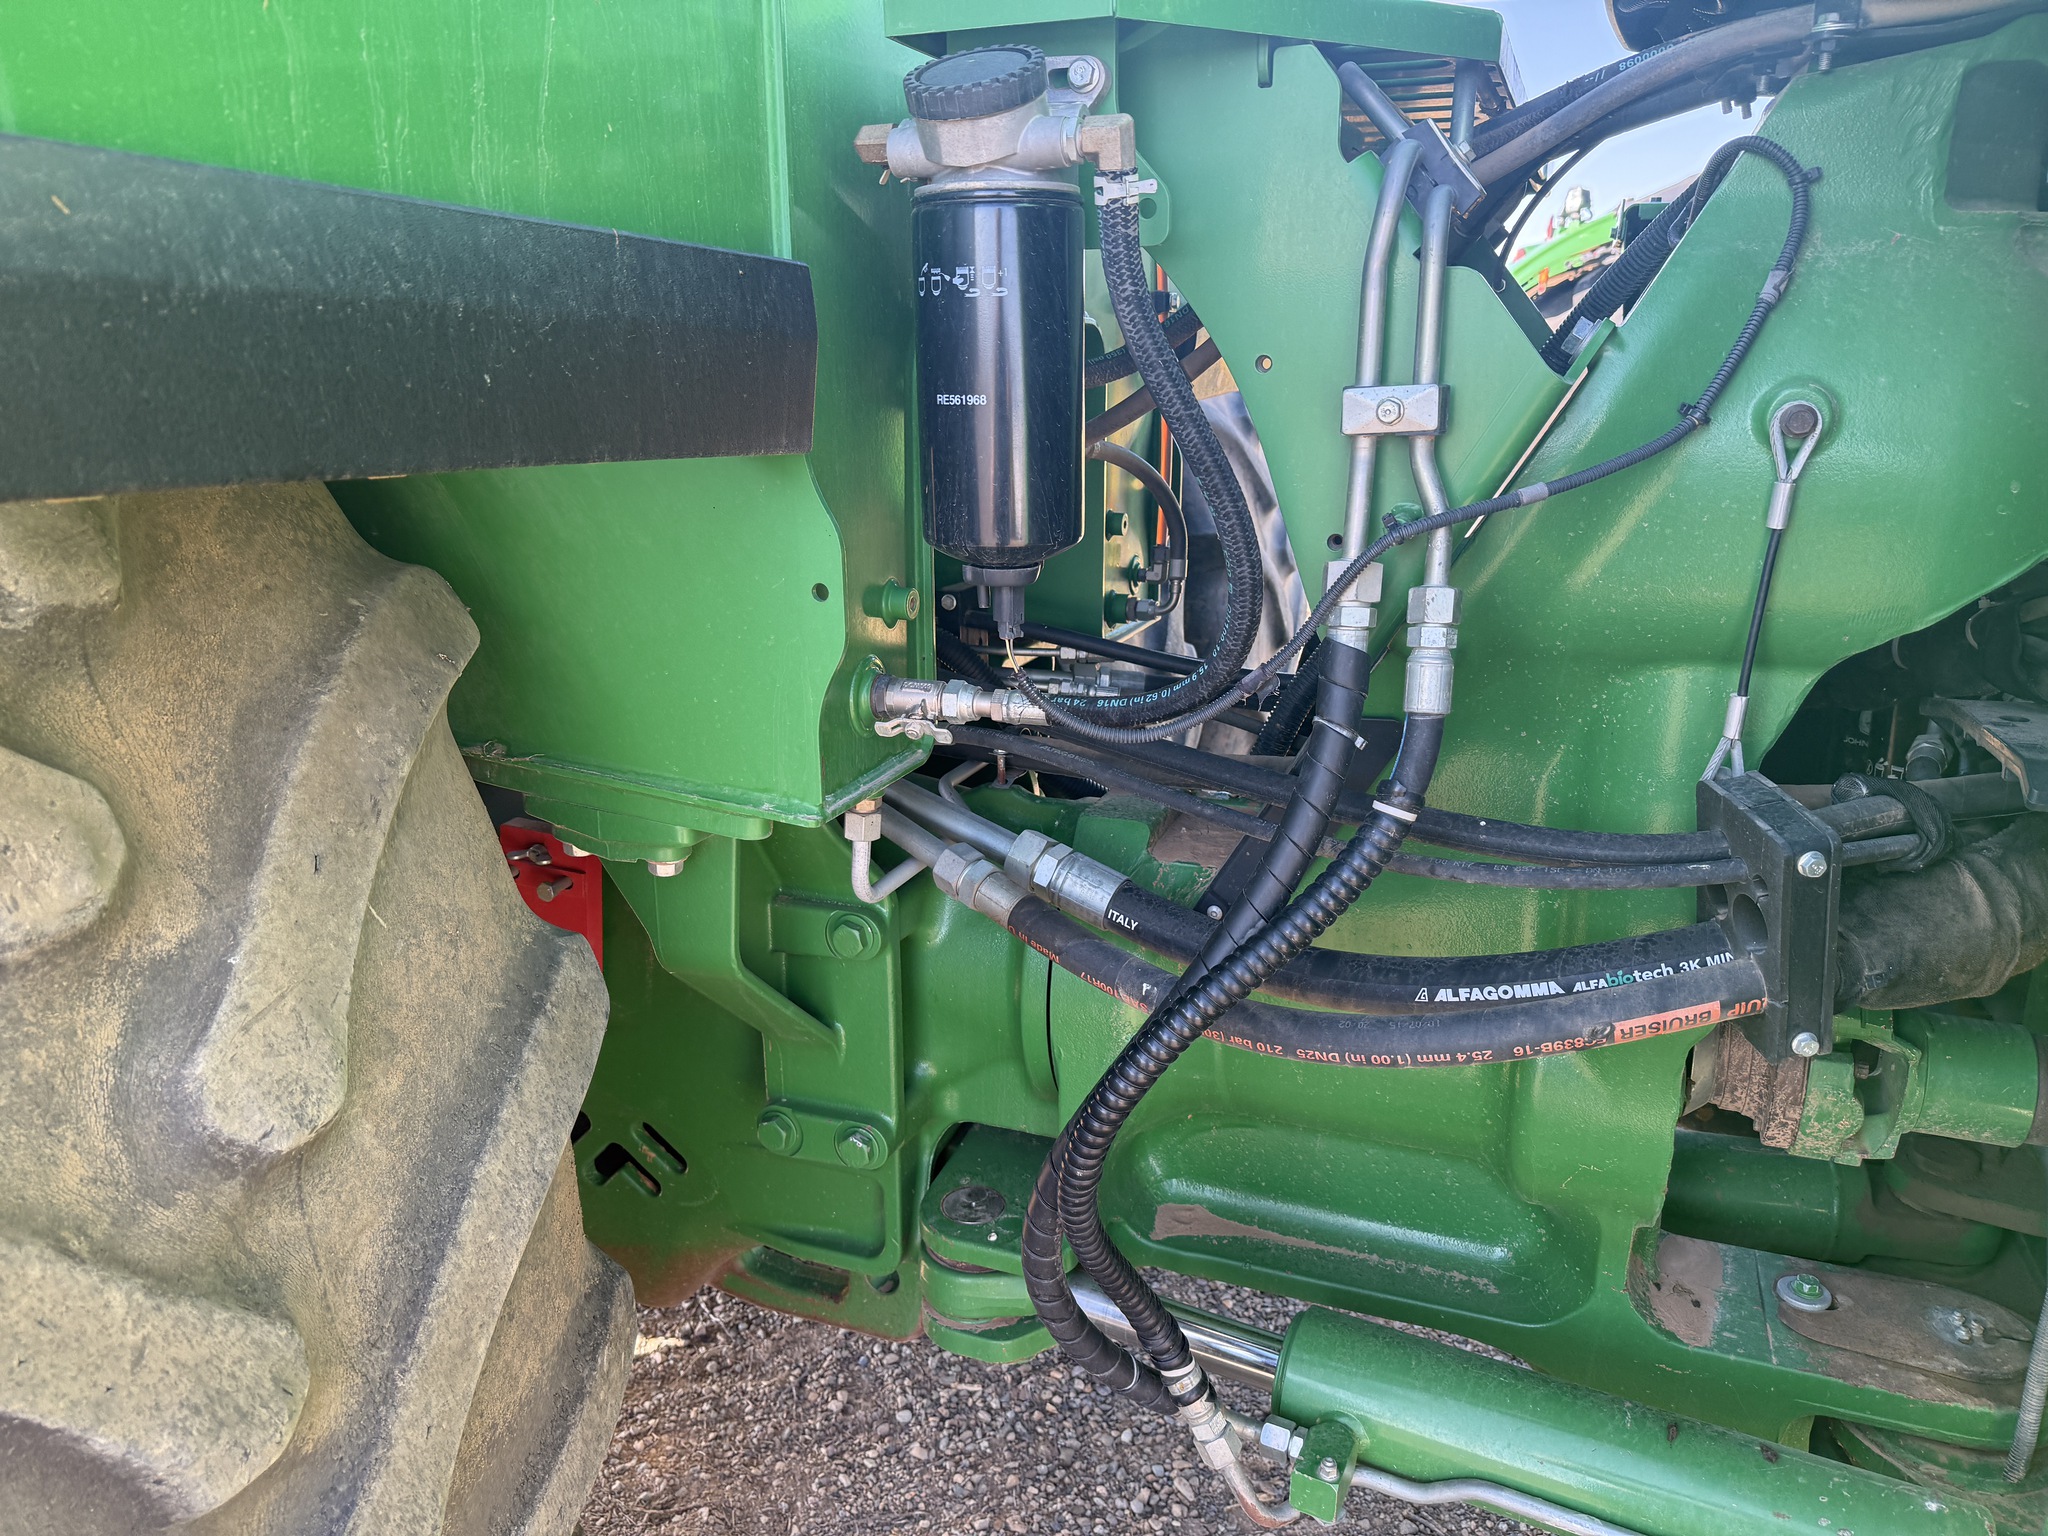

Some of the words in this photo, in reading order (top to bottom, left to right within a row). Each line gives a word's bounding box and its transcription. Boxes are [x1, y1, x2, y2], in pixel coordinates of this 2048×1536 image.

[936, 394, 987, 406] RE561968
[1173, 677, 1192, 692] mm
[1097, 697, 1128, 708] DN16
[1107, 908, 1139, 932] ITALY
[1434, 980, 1566, 1003] ALFAGOMMA
[1680, 957, 1701, 974] 3K
[1727, 997, 1768, 1017] UIP
[1620, 1010, 1712, 1040] BRUISER
[1201, 1027, 1225, 1043] (30
[1229, 1034, 1254, 1050] bar
[1256, 1041, 1284, 1056] 210
[1296, 1047, 1341, 1063] DN25
[1455, 1049, 1493, 1063] 25.4
[1345, 1051, 1367, 1067] in)
[1371, 1053, 1411, 1067] (1.00
[1416, 1051, 1451, 1065] mm
